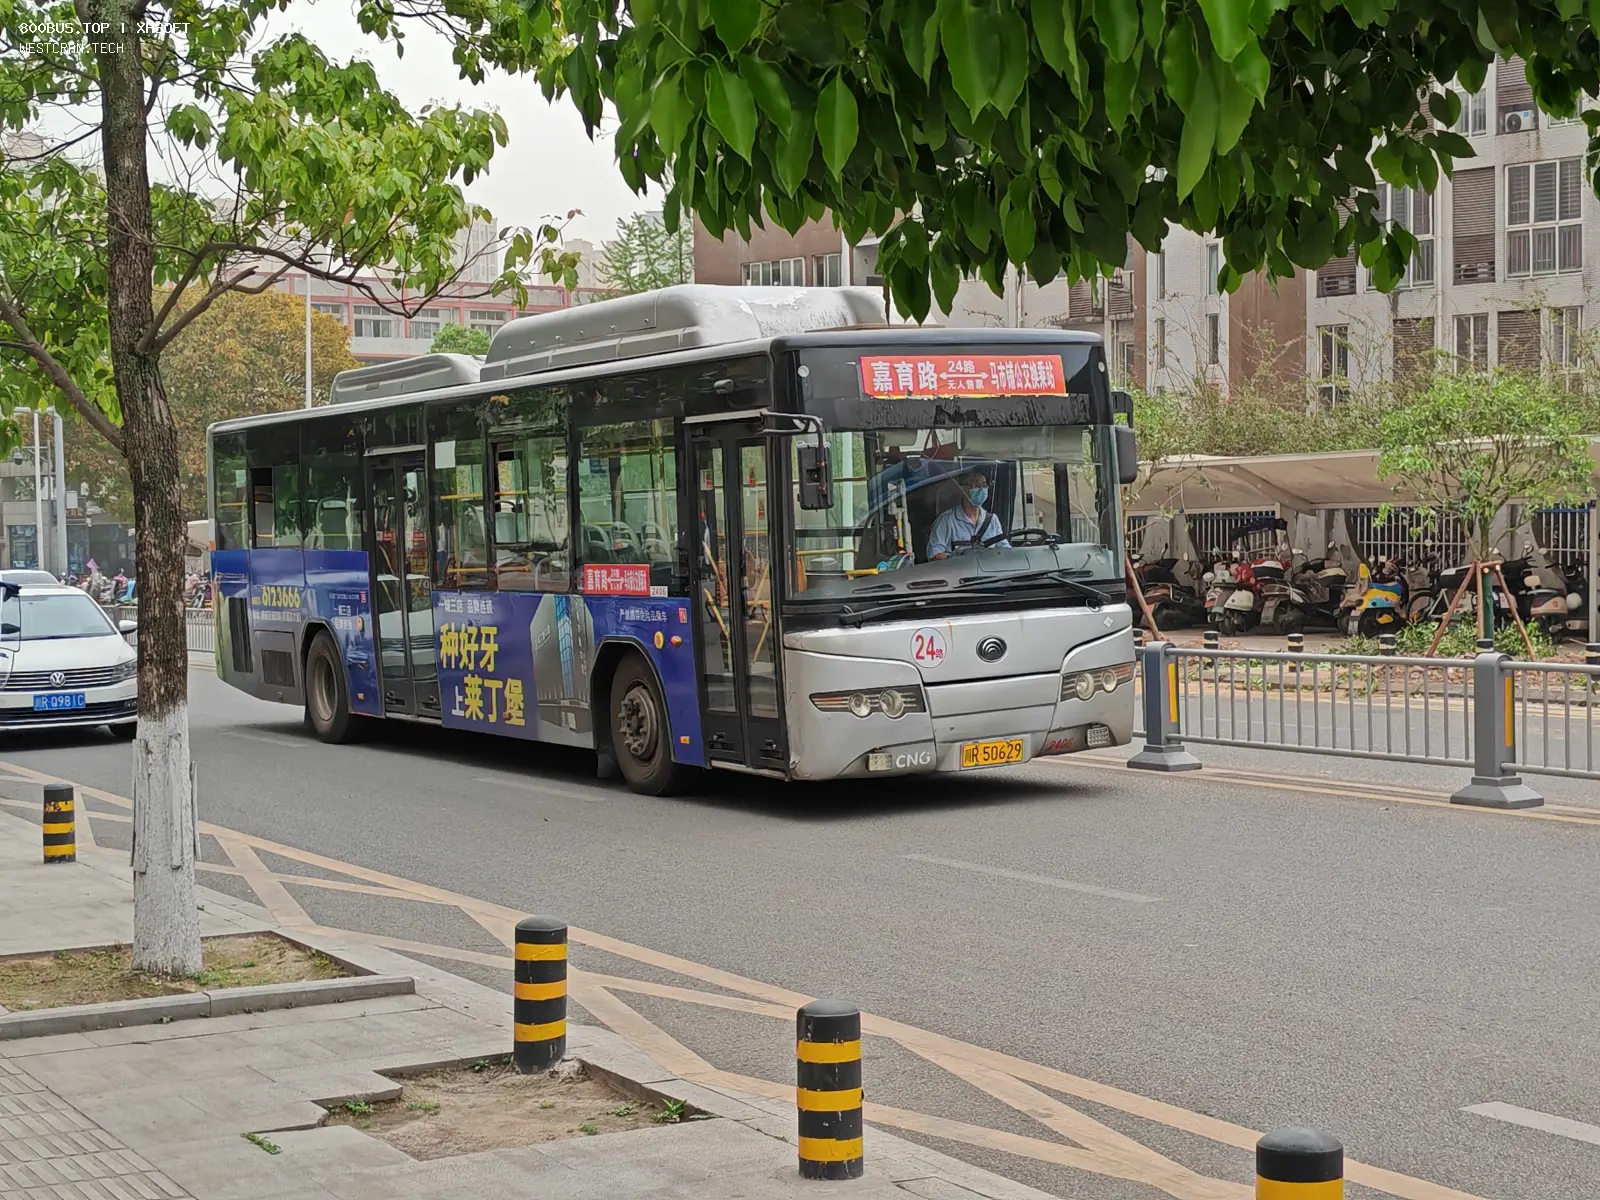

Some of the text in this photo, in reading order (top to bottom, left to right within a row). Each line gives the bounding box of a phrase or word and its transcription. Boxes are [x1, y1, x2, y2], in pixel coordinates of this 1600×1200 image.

[870, 360, 938, 392] 嘉育路
[948, 360, 975, 373] 24路
[262, 586, 301, 608] 6123666
[440, 622, 499, 672] 种好牙
[452, 673, 526, 727] 上莱丁堡
[895, 752, 931, 769] CNG
